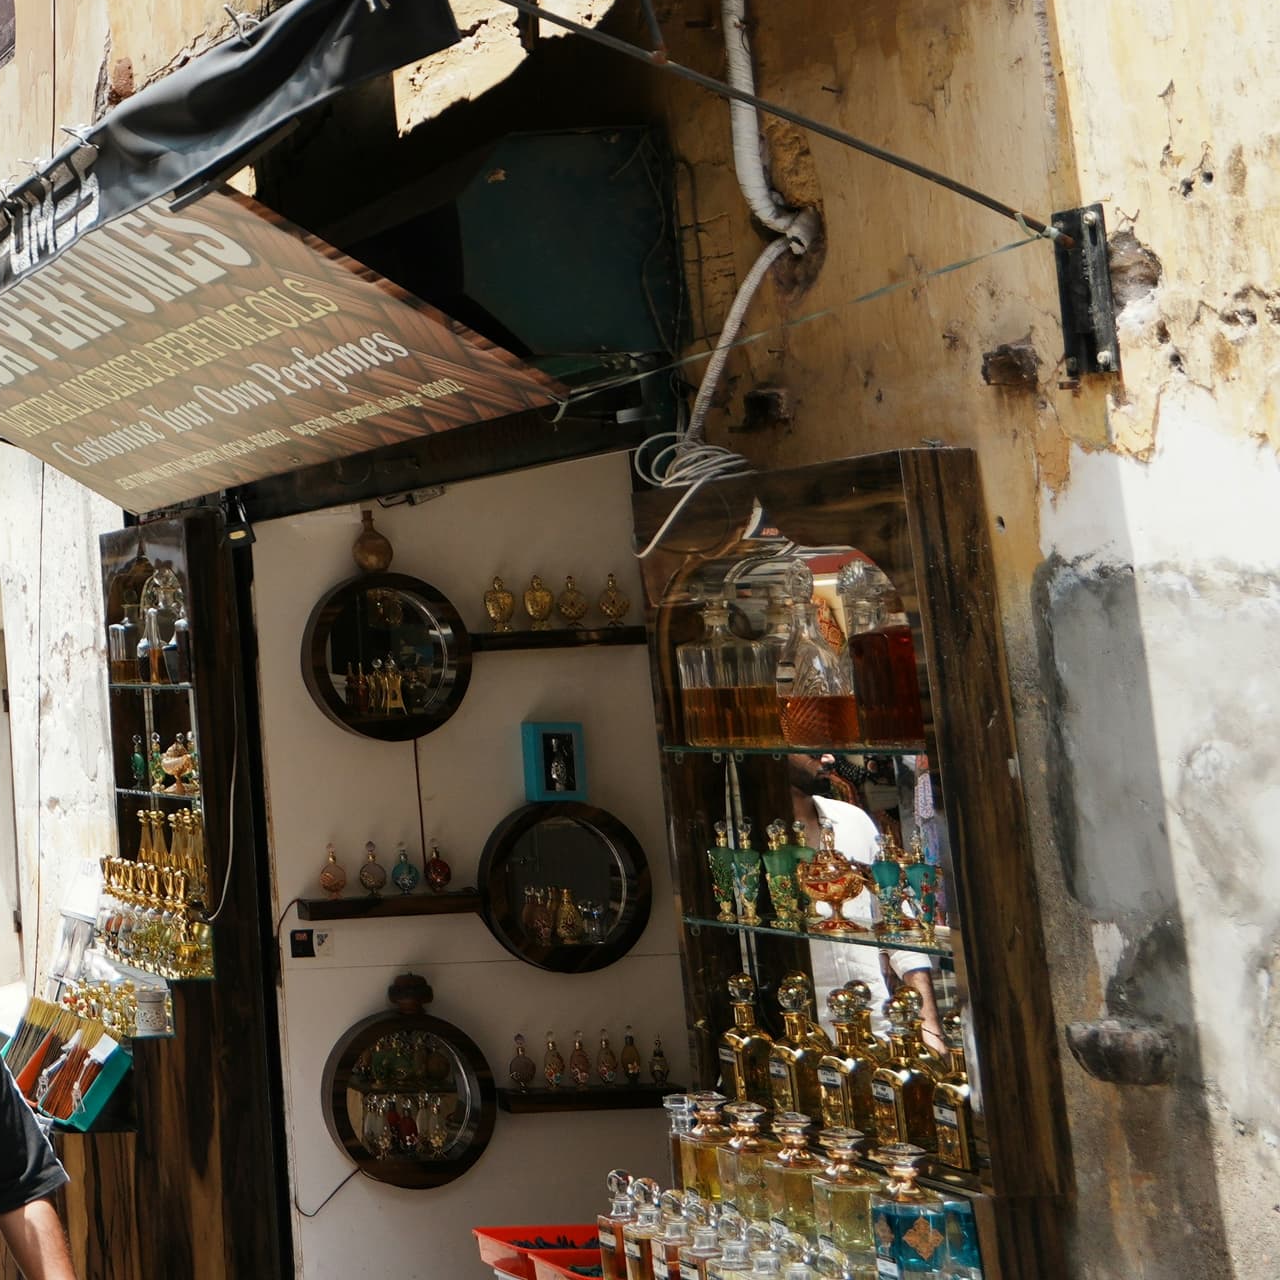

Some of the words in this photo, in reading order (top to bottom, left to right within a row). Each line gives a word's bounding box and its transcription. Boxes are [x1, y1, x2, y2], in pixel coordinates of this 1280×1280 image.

[244, 278, 338, 327] OILS
[143, 303, 280, 370] PERFUME
[59, 354, 164, 408] INCENSE
[129, 349, 180, 377] &
[416, 377, 464, 398] 682002
[51, 419, 164, 466] Customise
[138, 400, 213, 433] Your
[192, 380, 276, 414] Own
[248, 332, 407, 394] Perfumes
